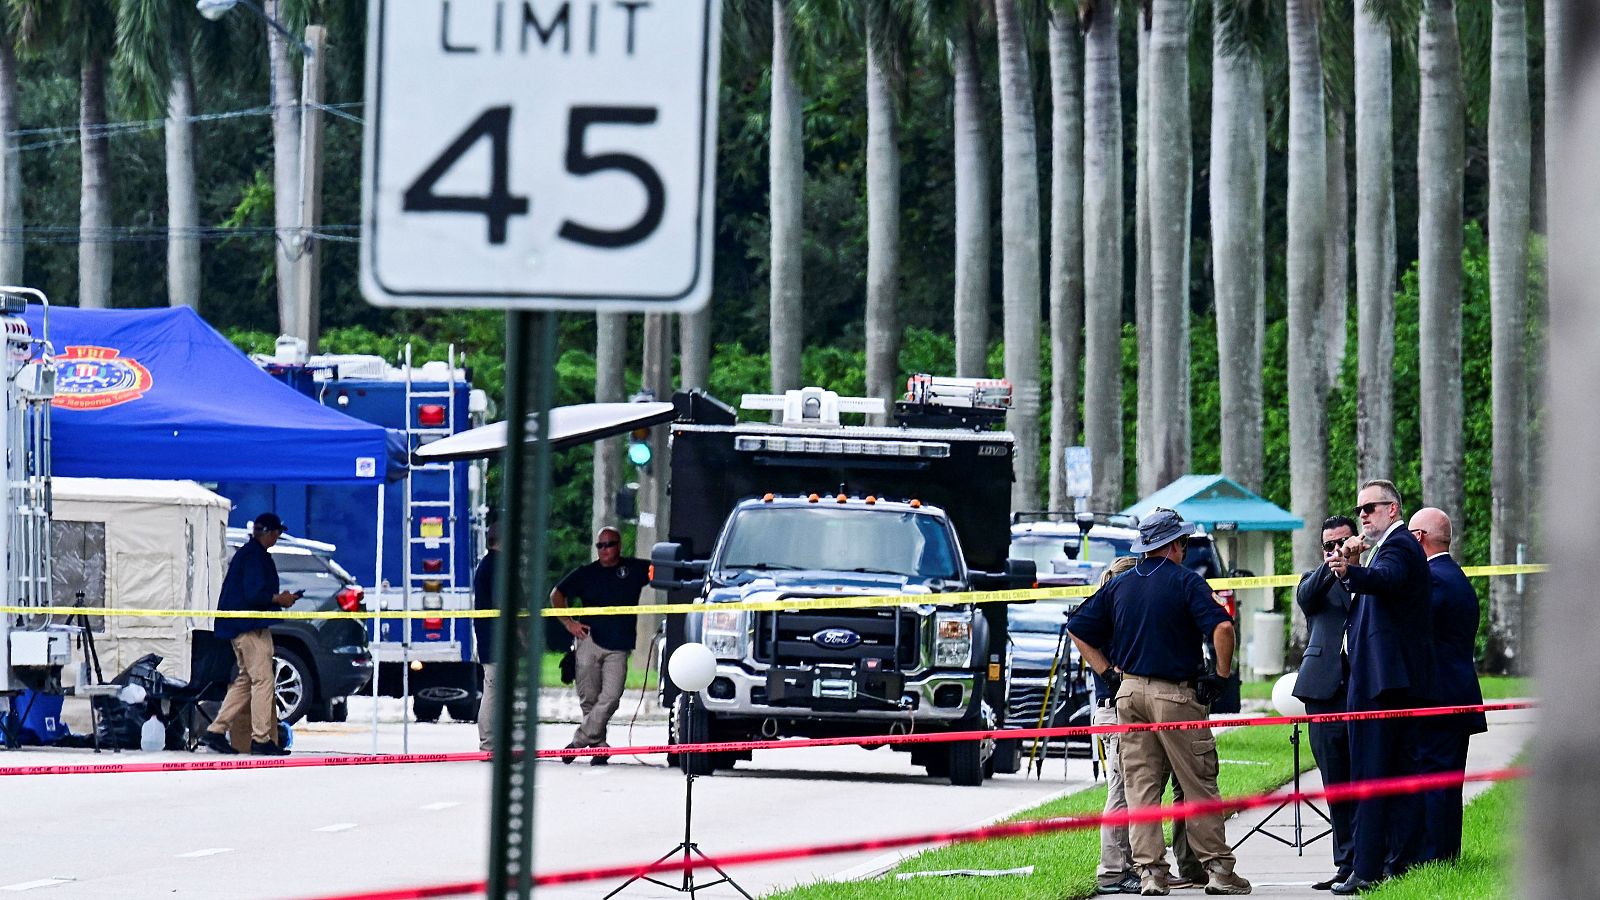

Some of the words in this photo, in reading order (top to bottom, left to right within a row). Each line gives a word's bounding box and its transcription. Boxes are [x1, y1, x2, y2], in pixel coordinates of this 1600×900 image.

[440, 0, 654, 55] LIMIT
[402, 104, 666, 249] 45
[77, 348, 105, 358] FBI
